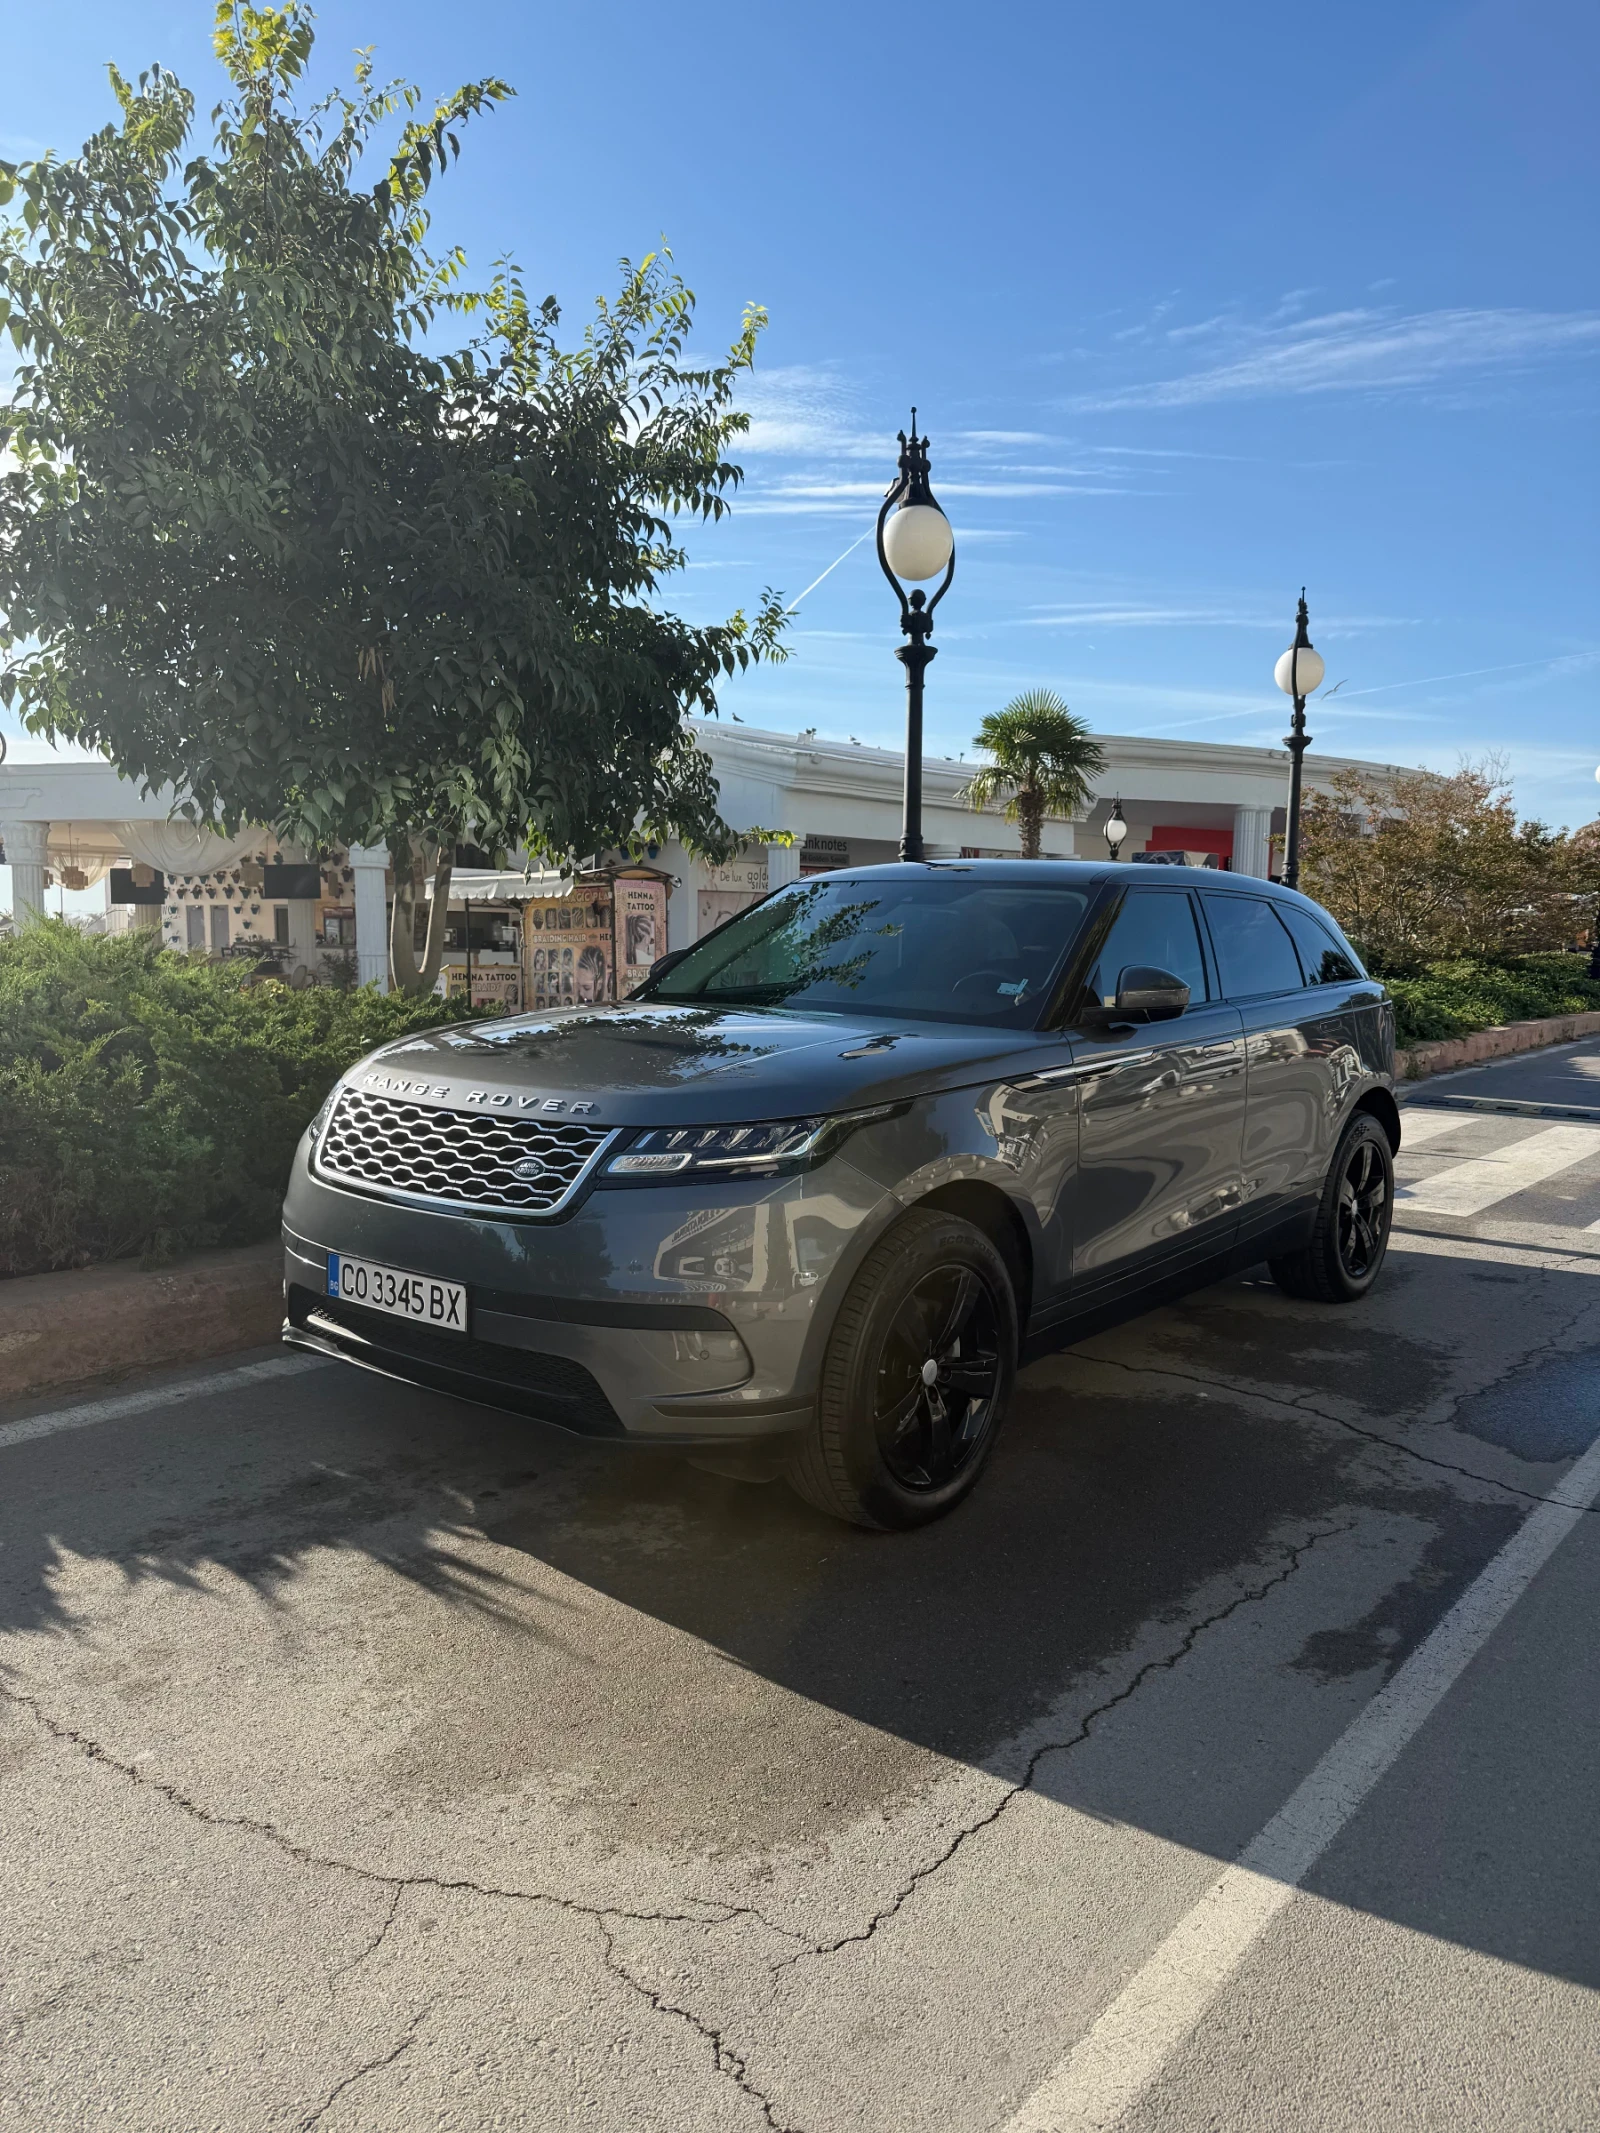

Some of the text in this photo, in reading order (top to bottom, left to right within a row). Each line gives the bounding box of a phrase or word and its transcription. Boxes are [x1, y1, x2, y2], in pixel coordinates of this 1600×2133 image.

[747, 867, 769, 884] gold
[592, 891, 611, 901] PLA
[627, 891, 654, 900] HENNA
[627, 902, 655, 911] TATTOO
[533, 934, 567, 943] BRAIDING
[567, 933, 587, 943] HAIR
[452, 972, 517, 982] HENNA TATTOO
[471, 982, 501, 993] BRAIDS
[363, 1074, 597, 1116] RANGE ROVER
[519, 1167, 539, 1175] ROVER
[939, 1234, 998, 1261] ECOSPORT
[329, 1279, 339, 1291] BG
[341, 1263, 461, 1325] CO 3345 BX
